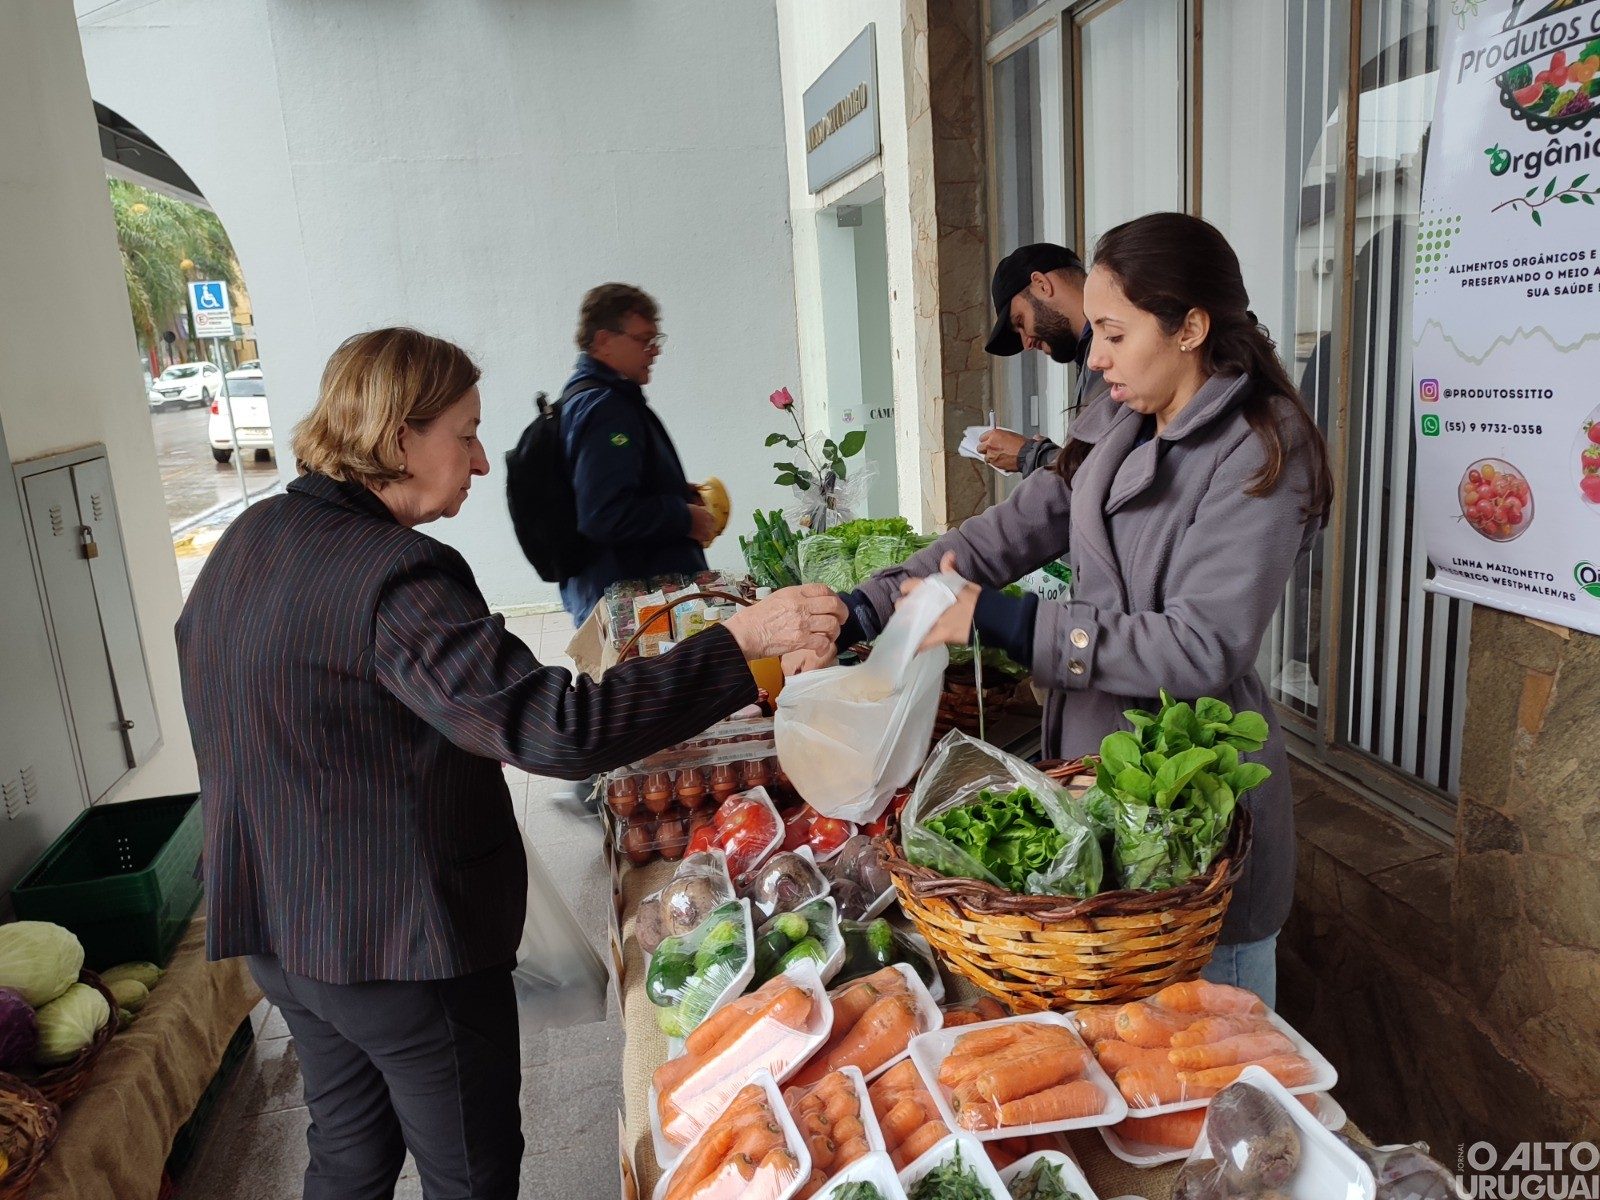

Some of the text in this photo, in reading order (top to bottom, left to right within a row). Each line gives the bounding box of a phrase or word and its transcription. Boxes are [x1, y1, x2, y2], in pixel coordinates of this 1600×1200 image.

[1449, 249, 1597, 274] ALIMENTOS ORGÂNICOS E
[1461, 272, 1541, 288] PRESERVANDO
[1545, 271, 1554, 280] O
[1558, 267, 1589, 279] MEIO
[1526, 287, 1550, 298] SUA
[1554, 282, 1593, 296] SAÚDE
[1443, 388, 1553, 399] @PRODUTOSSITIO
[1445, 420, 1543, 435] (55) 9 9732-0358
[1452, 557, 1554, 582] LINHA MAZZONETTO
[1492, 576, 1576, 601] WESTPHALEN/RS
